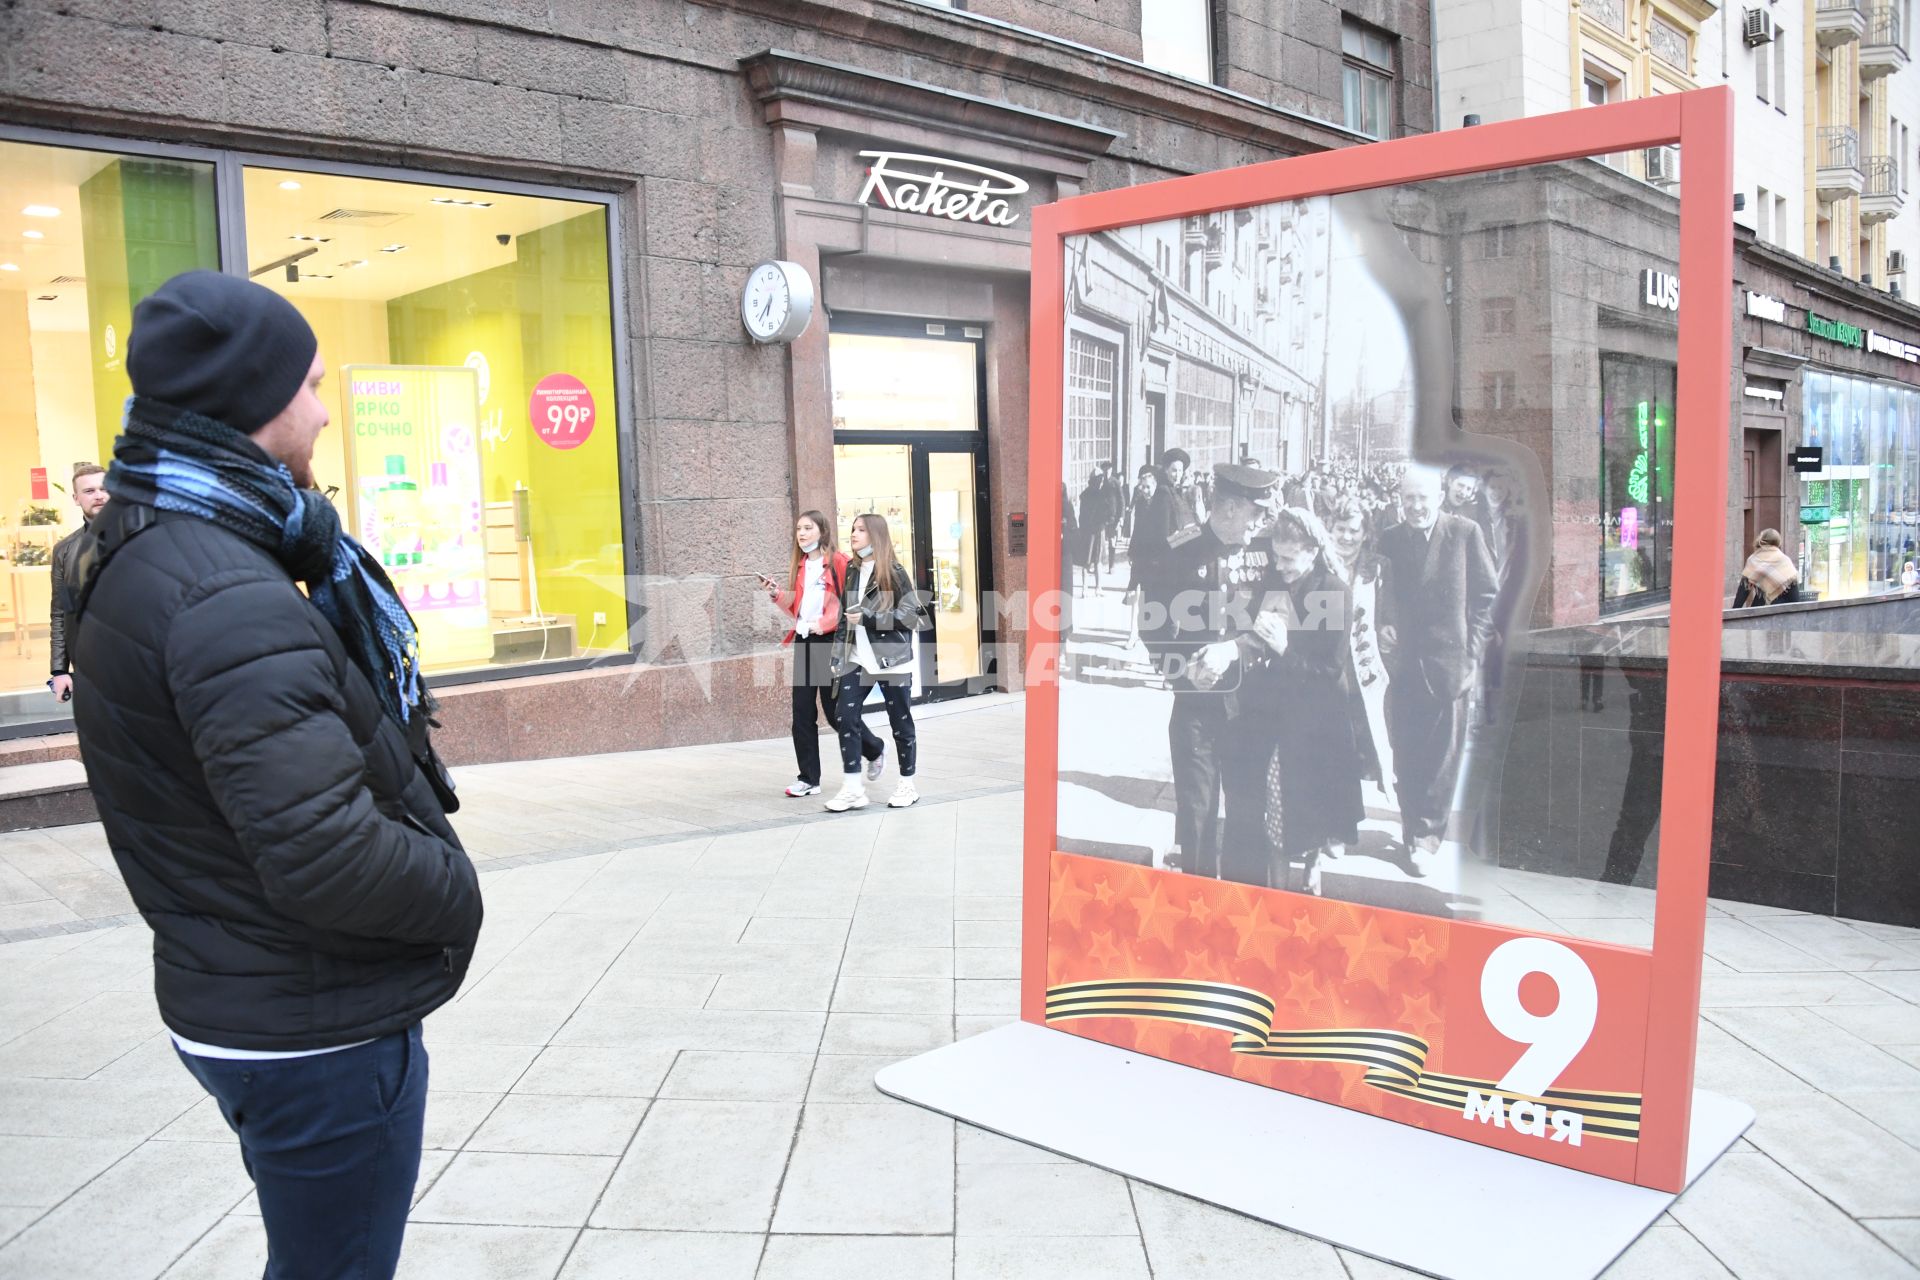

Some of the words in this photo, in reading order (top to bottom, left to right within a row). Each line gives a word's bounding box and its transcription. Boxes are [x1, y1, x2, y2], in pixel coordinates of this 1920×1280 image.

[859, 150, 1030, 226] Raketa
[1647, 268, 1680, 311] LUS
[353, 382, 401, 395] КИВИ
[356, 402, 400, 415] ЯРКО
[356, 422, 412, 435] СОЧНО
[1481, 937, 1598, 1097] 9
[1463, 1089, 1583, 1147] мая
